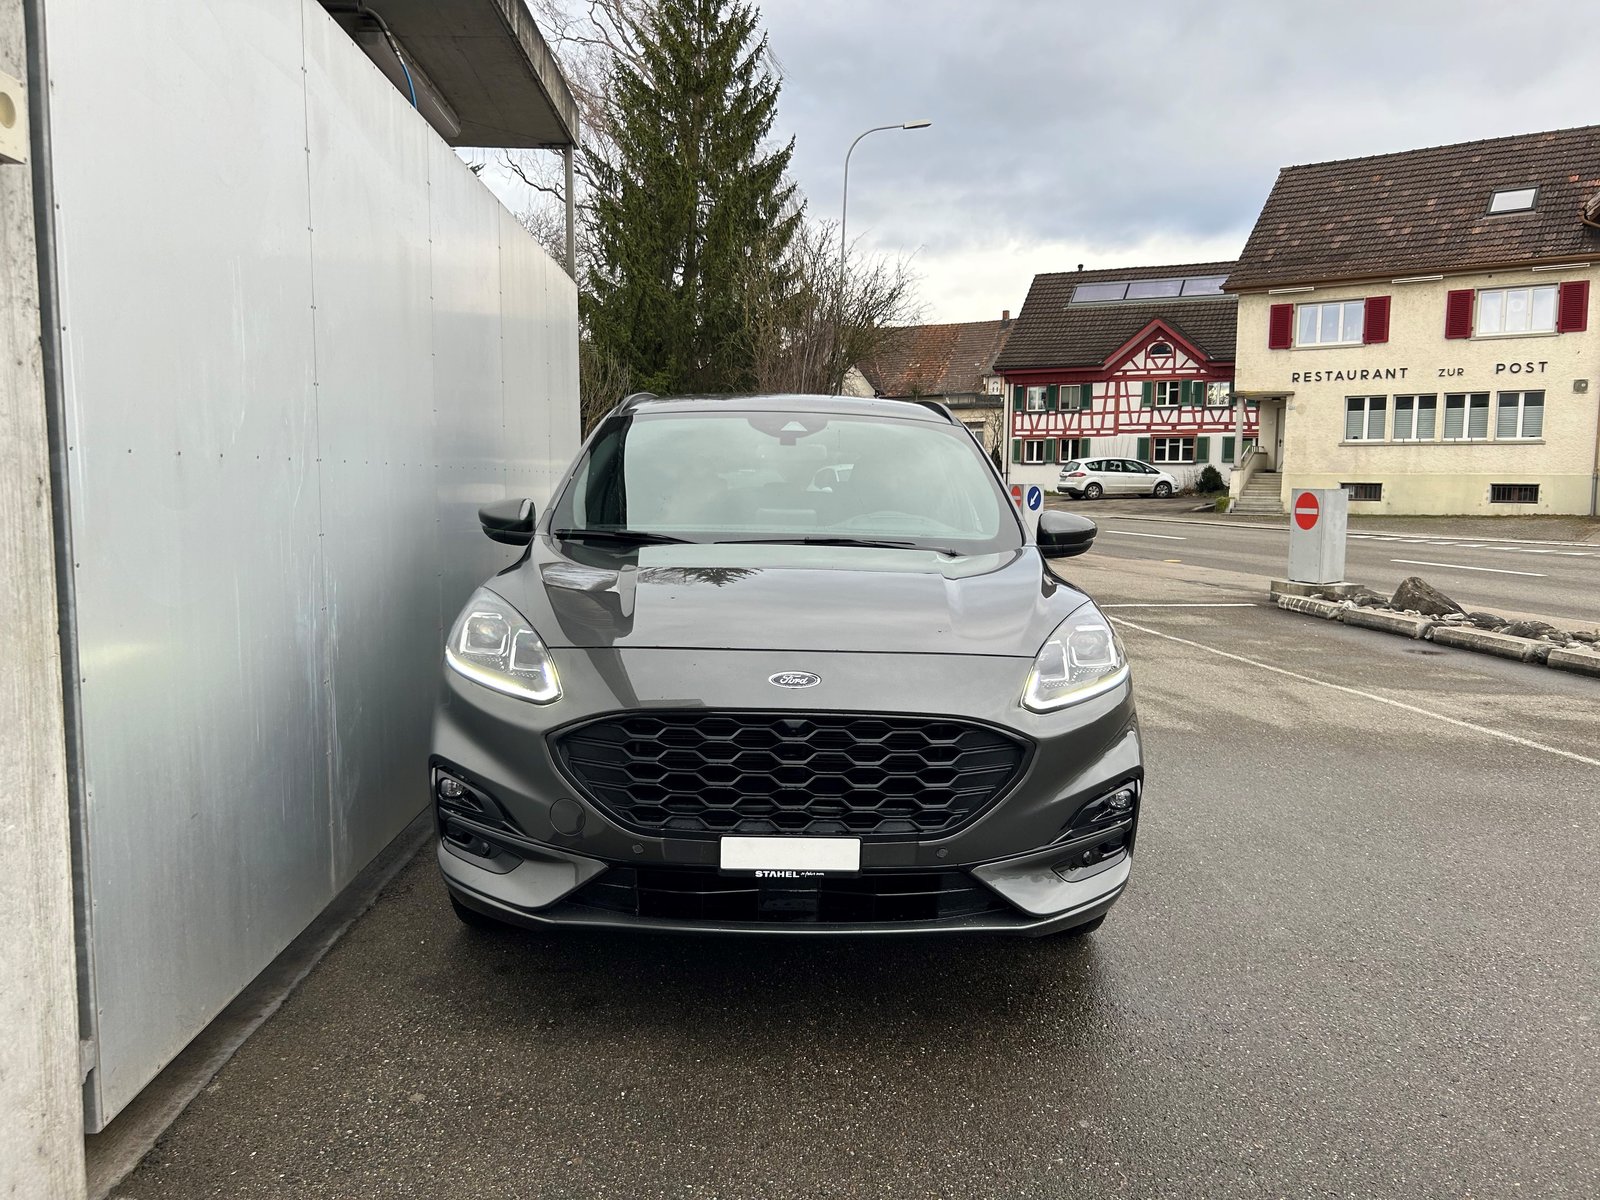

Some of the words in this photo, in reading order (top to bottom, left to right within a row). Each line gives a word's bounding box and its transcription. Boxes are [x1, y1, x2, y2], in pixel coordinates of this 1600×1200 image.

[1291, 367, 1408, 383] RESTAURANT
[1438, 367, 1465, 378] ZUR
[1495, 361, 1548, 375] POST
[779, 674, 809, 685] Ford
[755, 870, 800, 878] STAHEL
